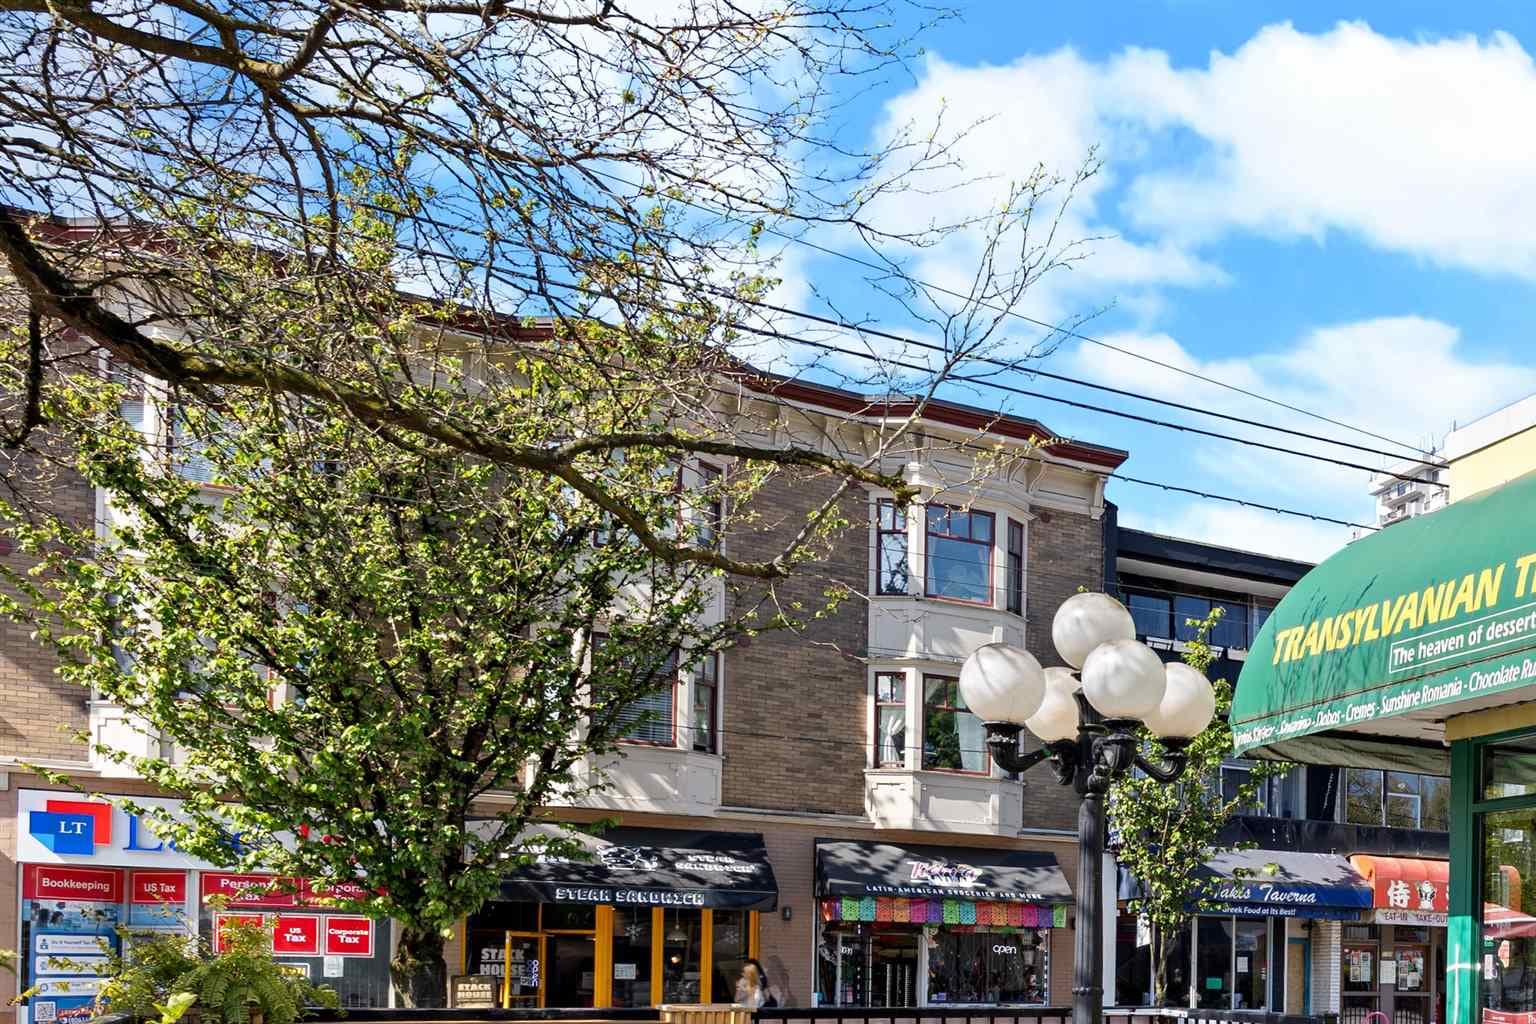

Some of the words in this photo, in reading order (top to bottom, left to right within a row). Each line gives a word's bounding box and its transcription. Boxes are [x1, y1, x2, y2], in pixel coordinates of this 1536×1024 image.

[1272, 563, 1506, 666] TRANSYLVANIAN
[1392, 644, 1415, 667] The
[1418, 634, 1464, 658] heaven
[1468, 625, 1483, 647] of
[1315, 709, 1342, 728] Dobos
[1346, 702, 1375, 722] Cremes
[1380, 690, 1422, 714] Sunshine
[1421, 677, 1463, 705] Romania
[1469, 666, 1520, 692] Chocolate
[58, 820, 87, 835] LT
[42, 877, 110, 892] Bookkeeping
[143, 882, 158, 892] US
[159, 883, 176, 893] Tax
[615, 890, 705, 905] SANDWICH
[1259, 883, 1317, 903] Taverna
[1243, 907, 1261, 915] Food
[284, 933, 306, 943] Tax
[328, 928, 369, 936] Corporate
[338, 934, 360, 944] Tax
